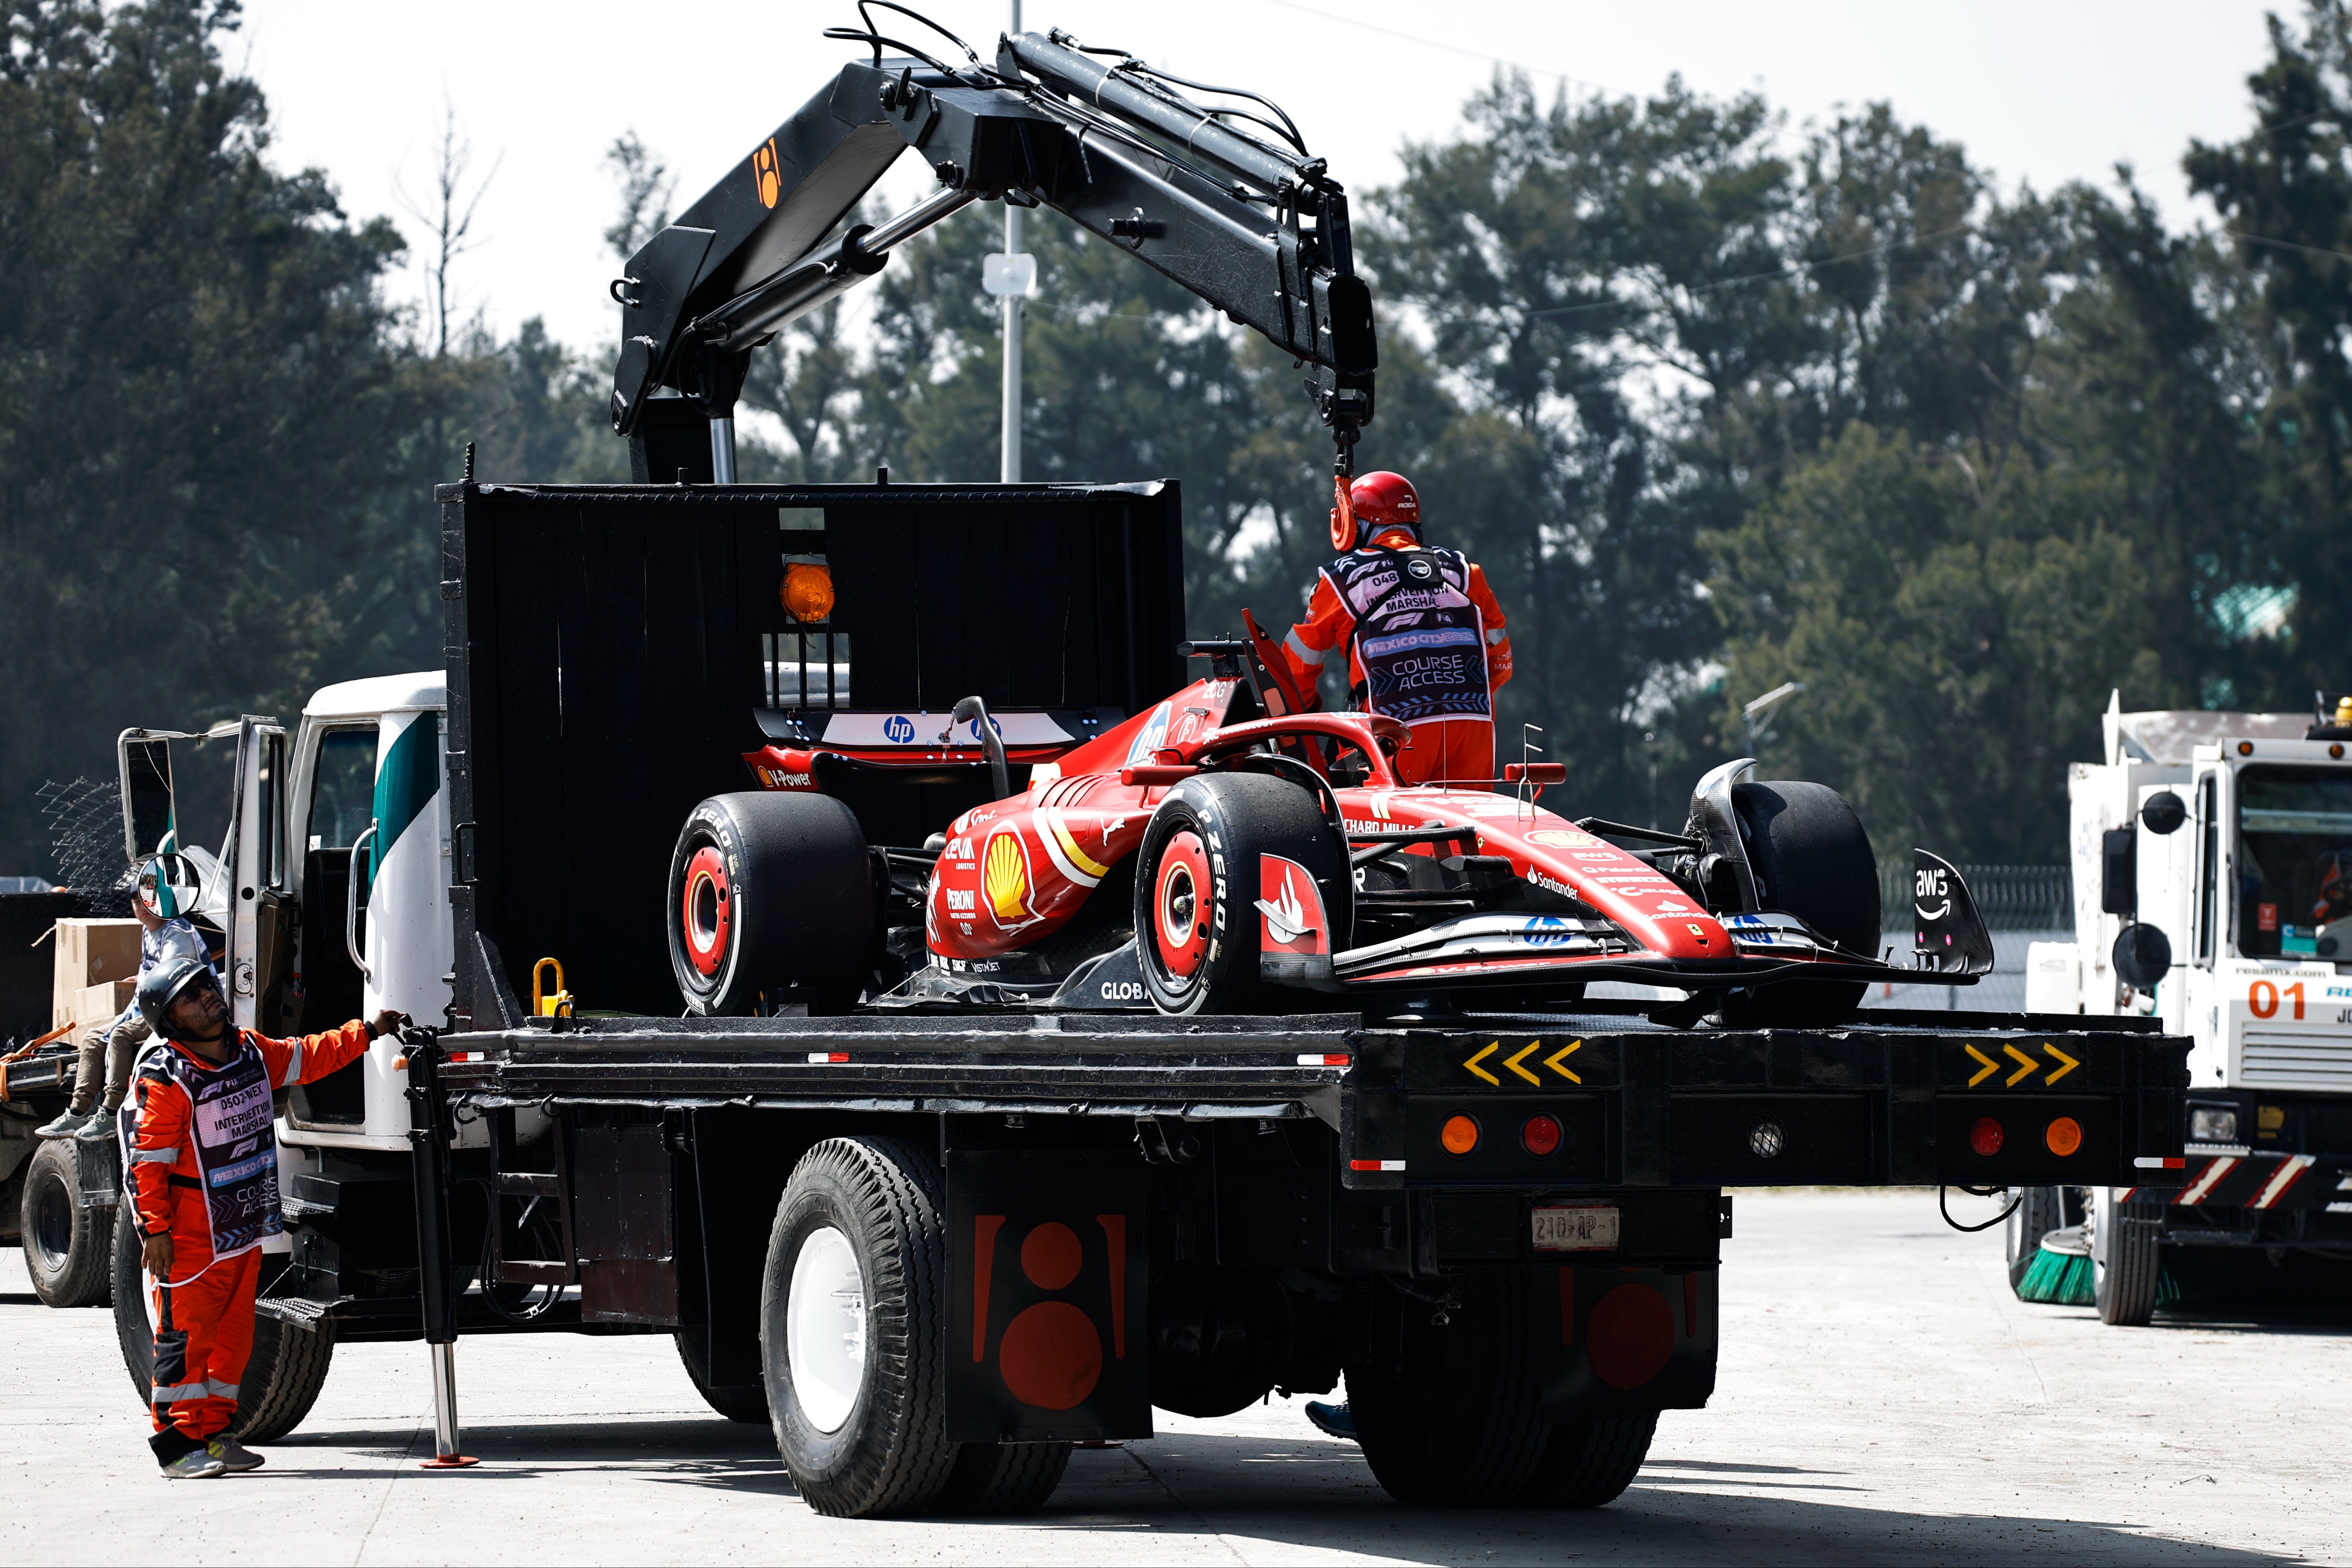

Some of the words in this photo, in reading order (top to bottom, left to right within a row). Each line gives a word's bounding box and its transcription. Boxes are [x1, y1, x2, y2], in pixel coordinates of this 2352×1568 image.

[1372, 572, 1398, 586] 048
[1386, 597, 1440, 612] MARSHAL
[1367, 636, 1417, 654] MEXICO
[1393, 655, 1464, 676] COURSE
[1399, 670, 1465, 691] ACCESS
[888, 715, 911, 743] hp
[770, 769, 811, 787] V-Power
[696, 808, 732, 847] ZERO
[1344, 819, 1380, 833] CHARD
[1198, 809, 1212, 823] P
[1208, 830, 1226, 932] ZERO
[1537, 872, 1578, 901] Santander
[1916, 868, 1948, 897] aws
[946, 888, 975, 910] PERONI
[952, 959, 966, 972] SKF
[1437, 962, 1551, 973] V-Power
[2236, 967, 2326, 977] resamx.com
[2249, 980, 2305, 1020] 01
[213, 1161, 256, 1184] MEXICO
[236, 1176, 277, 1202] COURS
[241, 1191, 279, 1217] ACCES
